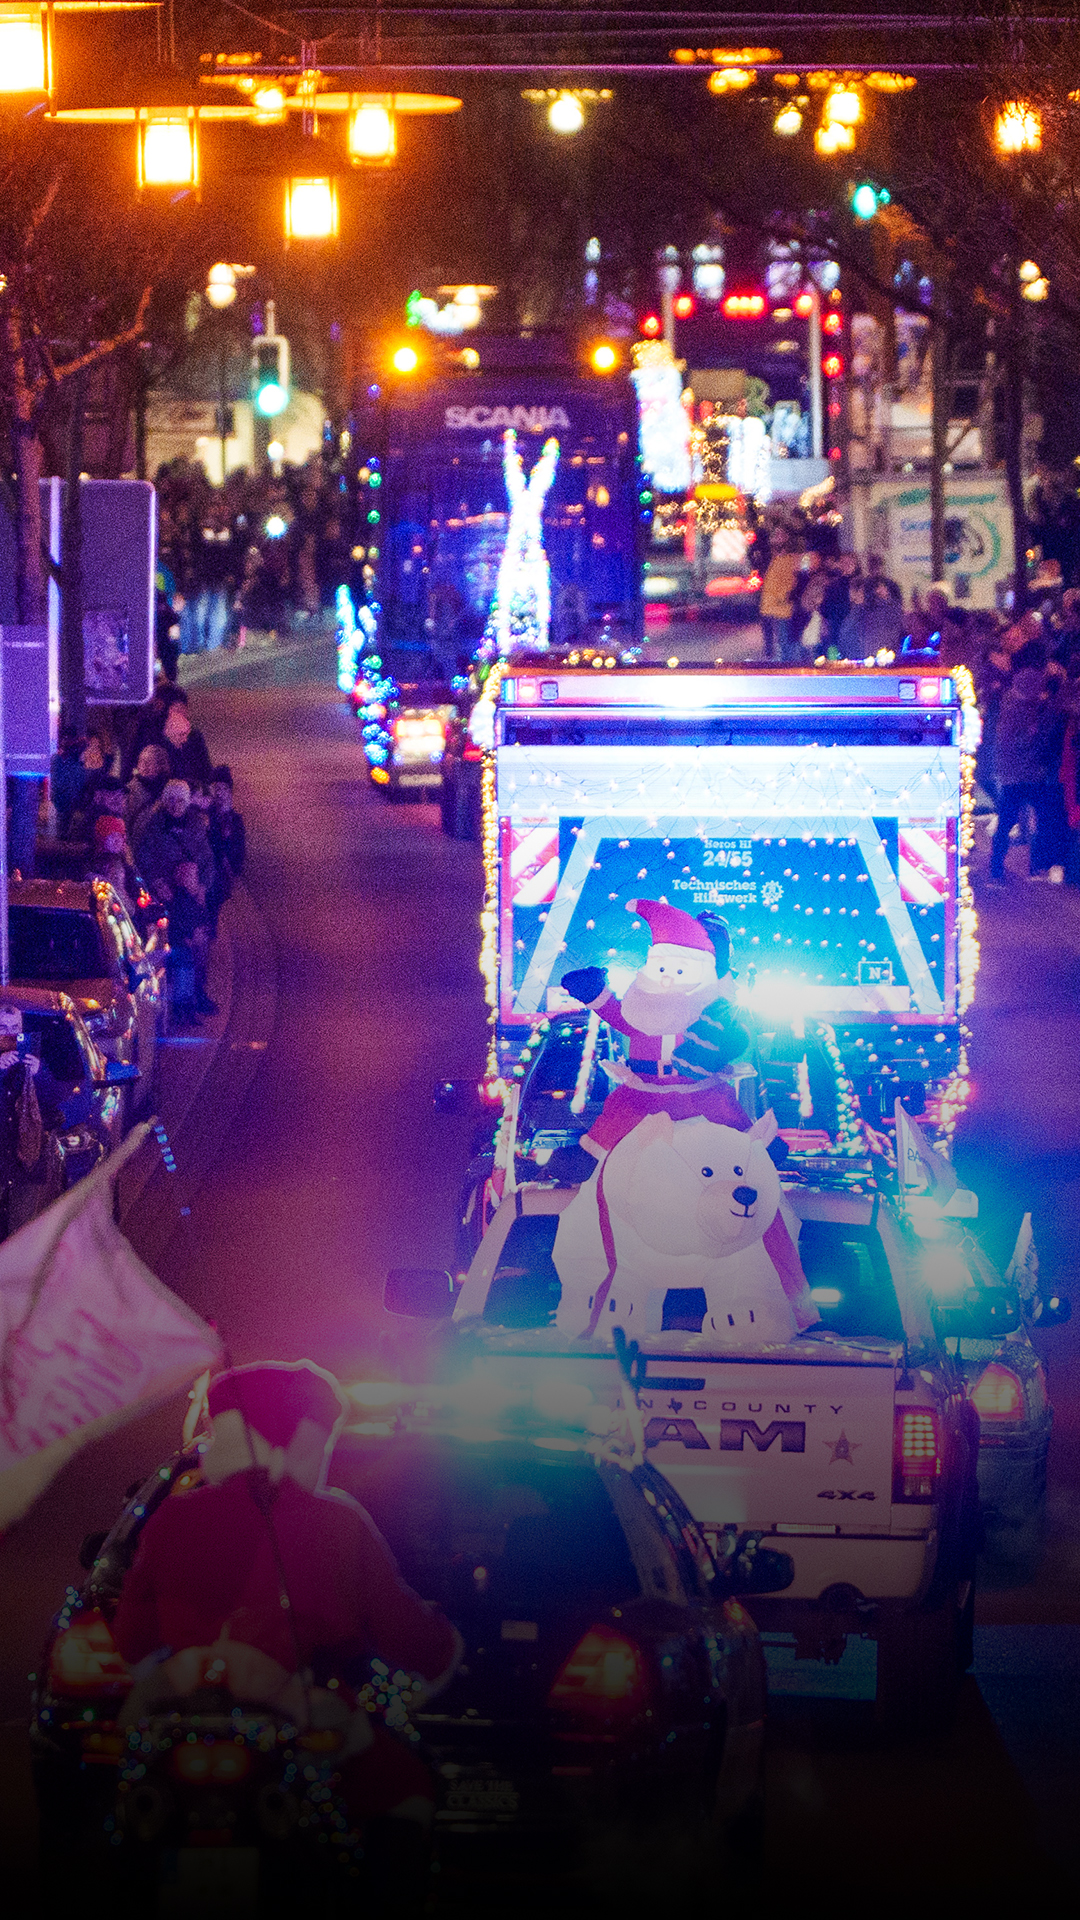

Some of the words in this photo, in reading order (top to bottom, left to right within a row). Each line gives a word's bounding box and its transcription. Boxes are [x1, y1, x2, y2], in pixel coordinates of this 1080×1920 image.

[445, 405, 570, 429] SCANIA
[672, 879, 757, 891] Technisches
[869, 967, 881, 979] N
[693, 1400, 843, 1415] COUNTY
[644, 1417, 806, 1453] AM
[446, 1794, 519, 1811] CLASSICS
